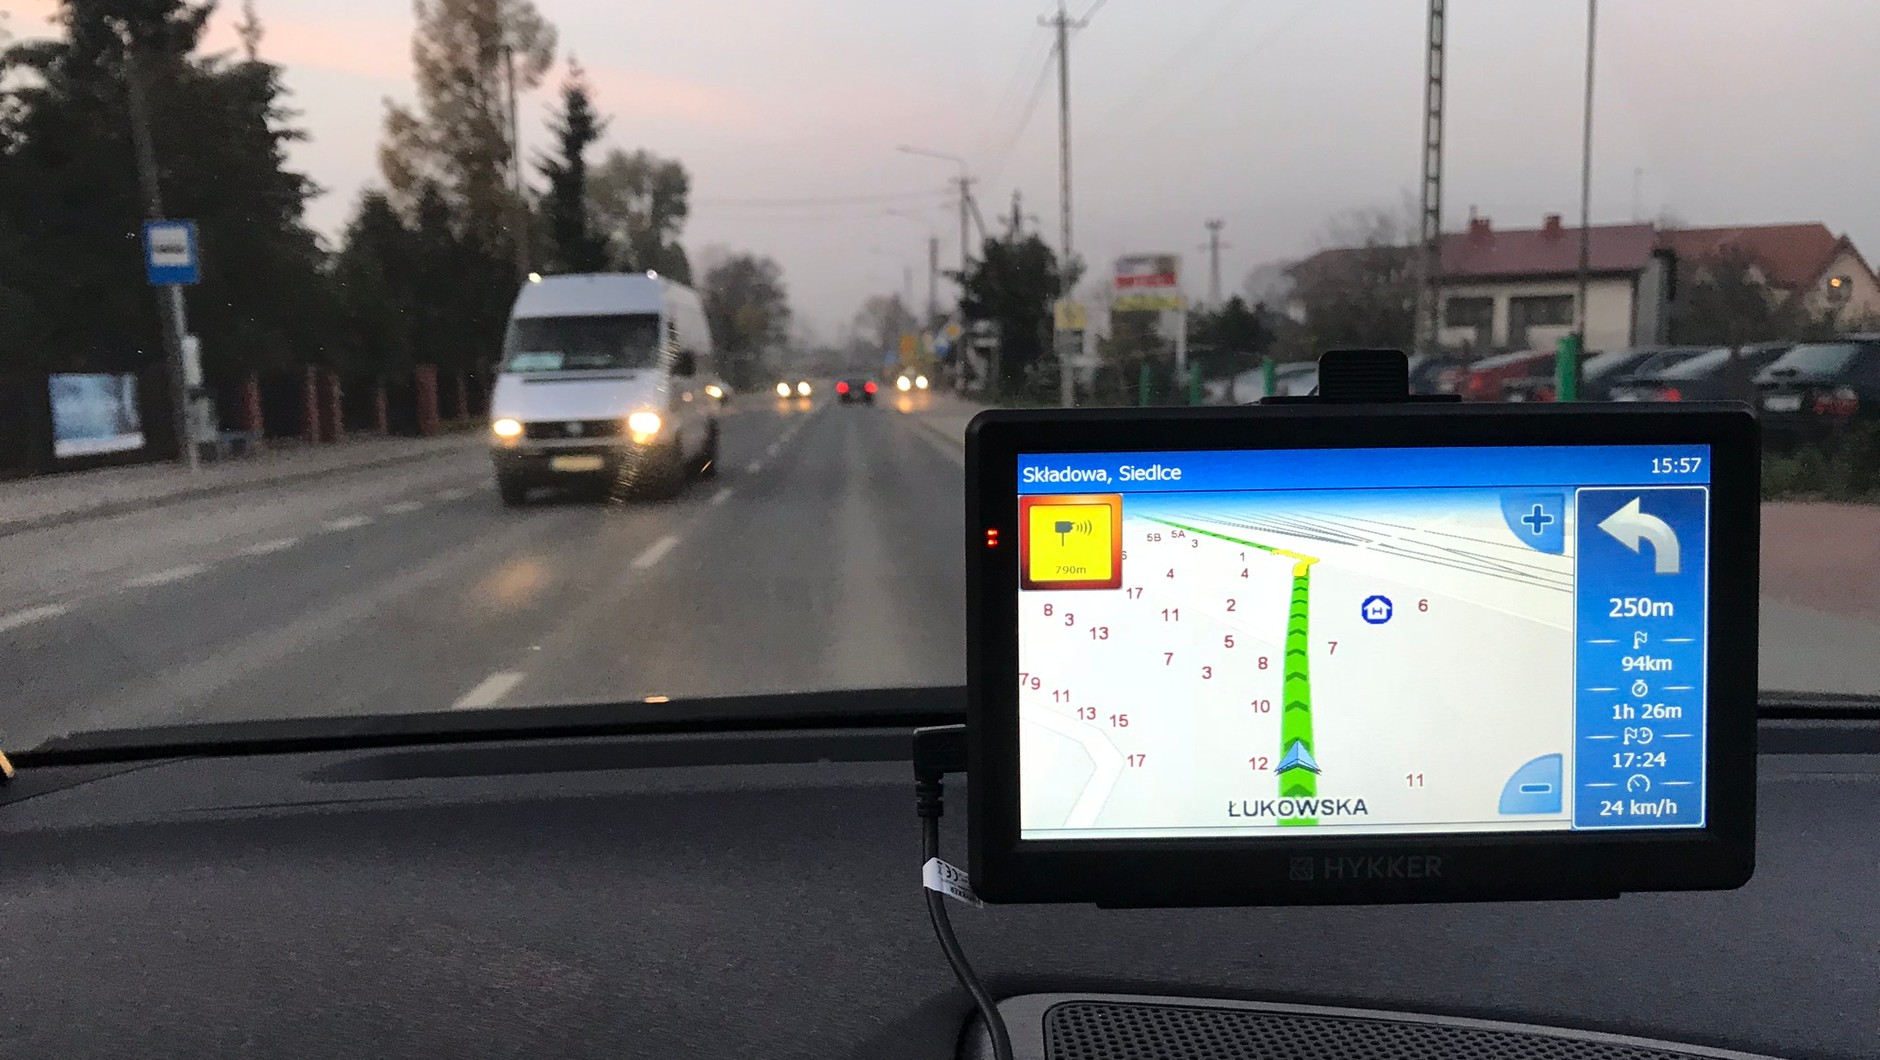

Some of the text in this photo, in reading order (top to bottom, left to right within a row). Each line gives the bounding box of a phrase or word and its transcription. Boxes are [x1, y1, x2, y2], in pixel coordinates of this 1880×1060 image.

[1651, 457, 1702, 474] 15:57
[1022, 464, 1182, 485] Składowa, Siedlce
[1146, 532, 1162, 543] 5B
[1170, 529, 1187, 539] 5A
[1191, 538, 1199, 549] 3
[1239, 551, 1245, 562] 1
[1055, 565, 1087, 575] 790m
[1166, 568, 1175, 579] 4
[1240, 567, 1249, 579] 4
[1126, 587, 1144, 600] 17
[1043, 603, 1054, 617] 8
[1226, 598, 1236, 612] 2
[1418, 598, 1429, 613] 6
[1609, 597, 1674, 618] 250m
[1064, 612, 1075, 627] 3
[1161, 608, 1179, 622] 11
[1089, 626, 1109, 641] 13
[1224, 634, 1235, 649] 5
[1327, 641, 1338, 655] 7
[1163, 652, 1174, 666] 7
[1257, 656, 1269, 670] 8
[1621, 655, 1673, 672] 94km
[1201, 665, 1212, 680] 3
[1030, 676, 1041, 691] 9
[1052, 689, 1070, 703] 11
[1077, 706, 1097, 721] 13
[1251, 699, 1271, 714] 10
[1612, 703, 1683, 720] 1h 26m
[1109, 713, 1129, 728] 15
[1127, 753, 1147, 768] 17
[1248, 756, 1269, 771] 12
[1612, 751, 1667, 769] 17:24
[1406, 773, 1423, 787] 11
[1228, 798, 1369, 818] ŁUKOWSKA
[1599, 798, 1678, 818] 24 km/h
[1325, 855, 1442, 879] HYKKER
